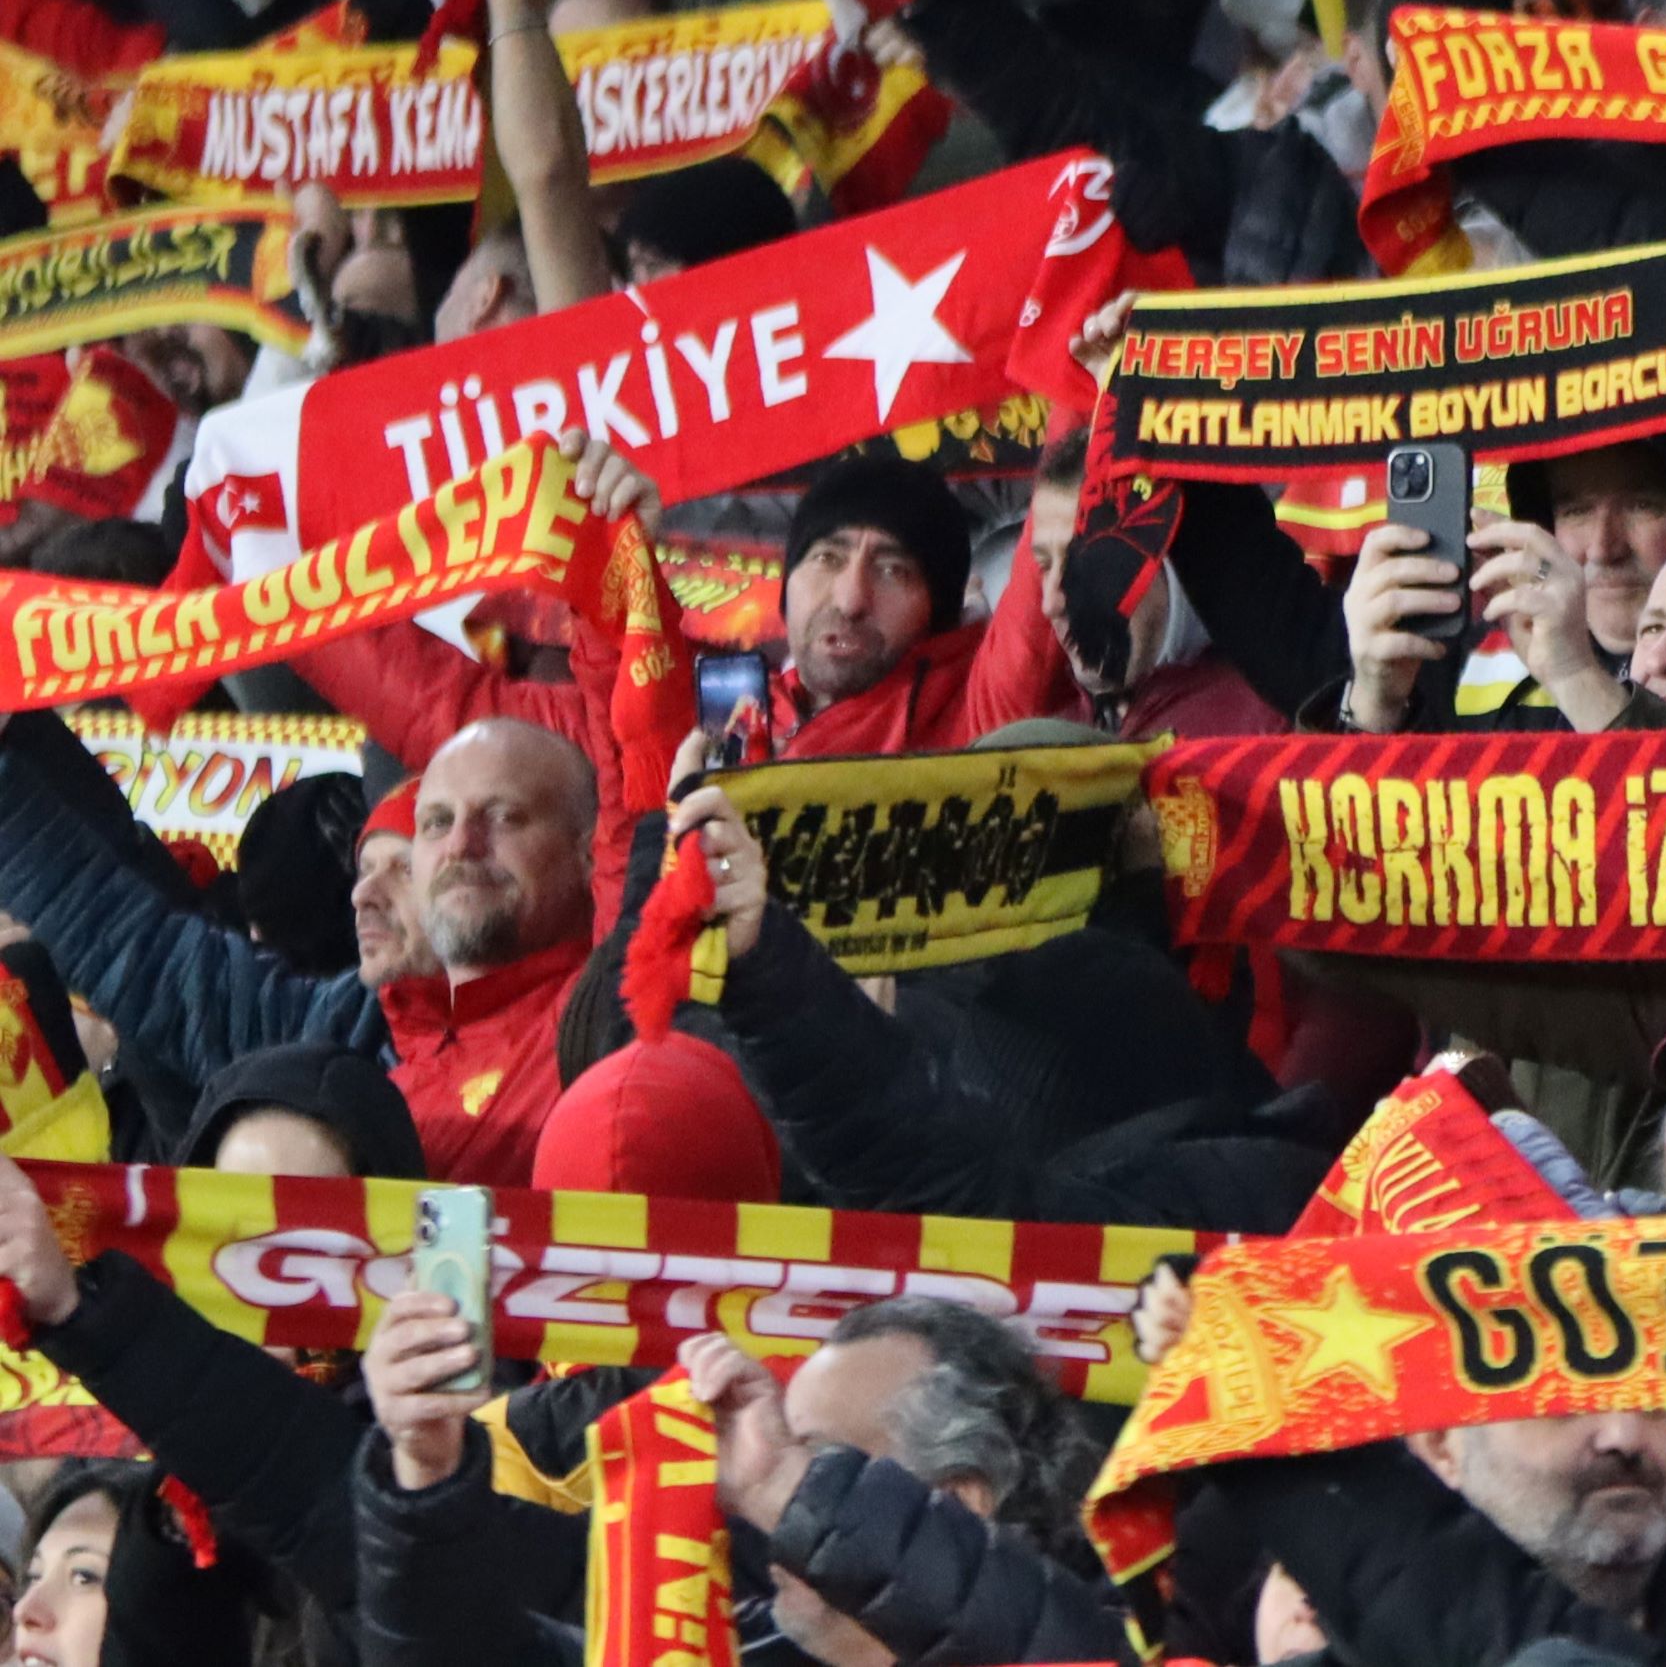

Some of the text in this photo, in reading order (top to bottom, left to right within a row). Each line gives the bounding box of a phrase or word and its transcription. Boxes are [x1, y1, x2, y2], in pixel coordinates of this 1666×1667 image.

[201, 85, 379, 180] MUSTAFA
[1121, 288, 1634, 390] HERŞEY SENİN UĞRUNA
[1139, 394, 1402, 447] KATLANMAK
[1409, 377, 1548, 439] BOYUN
[1279, 773, 1598, 928] KORKMA
